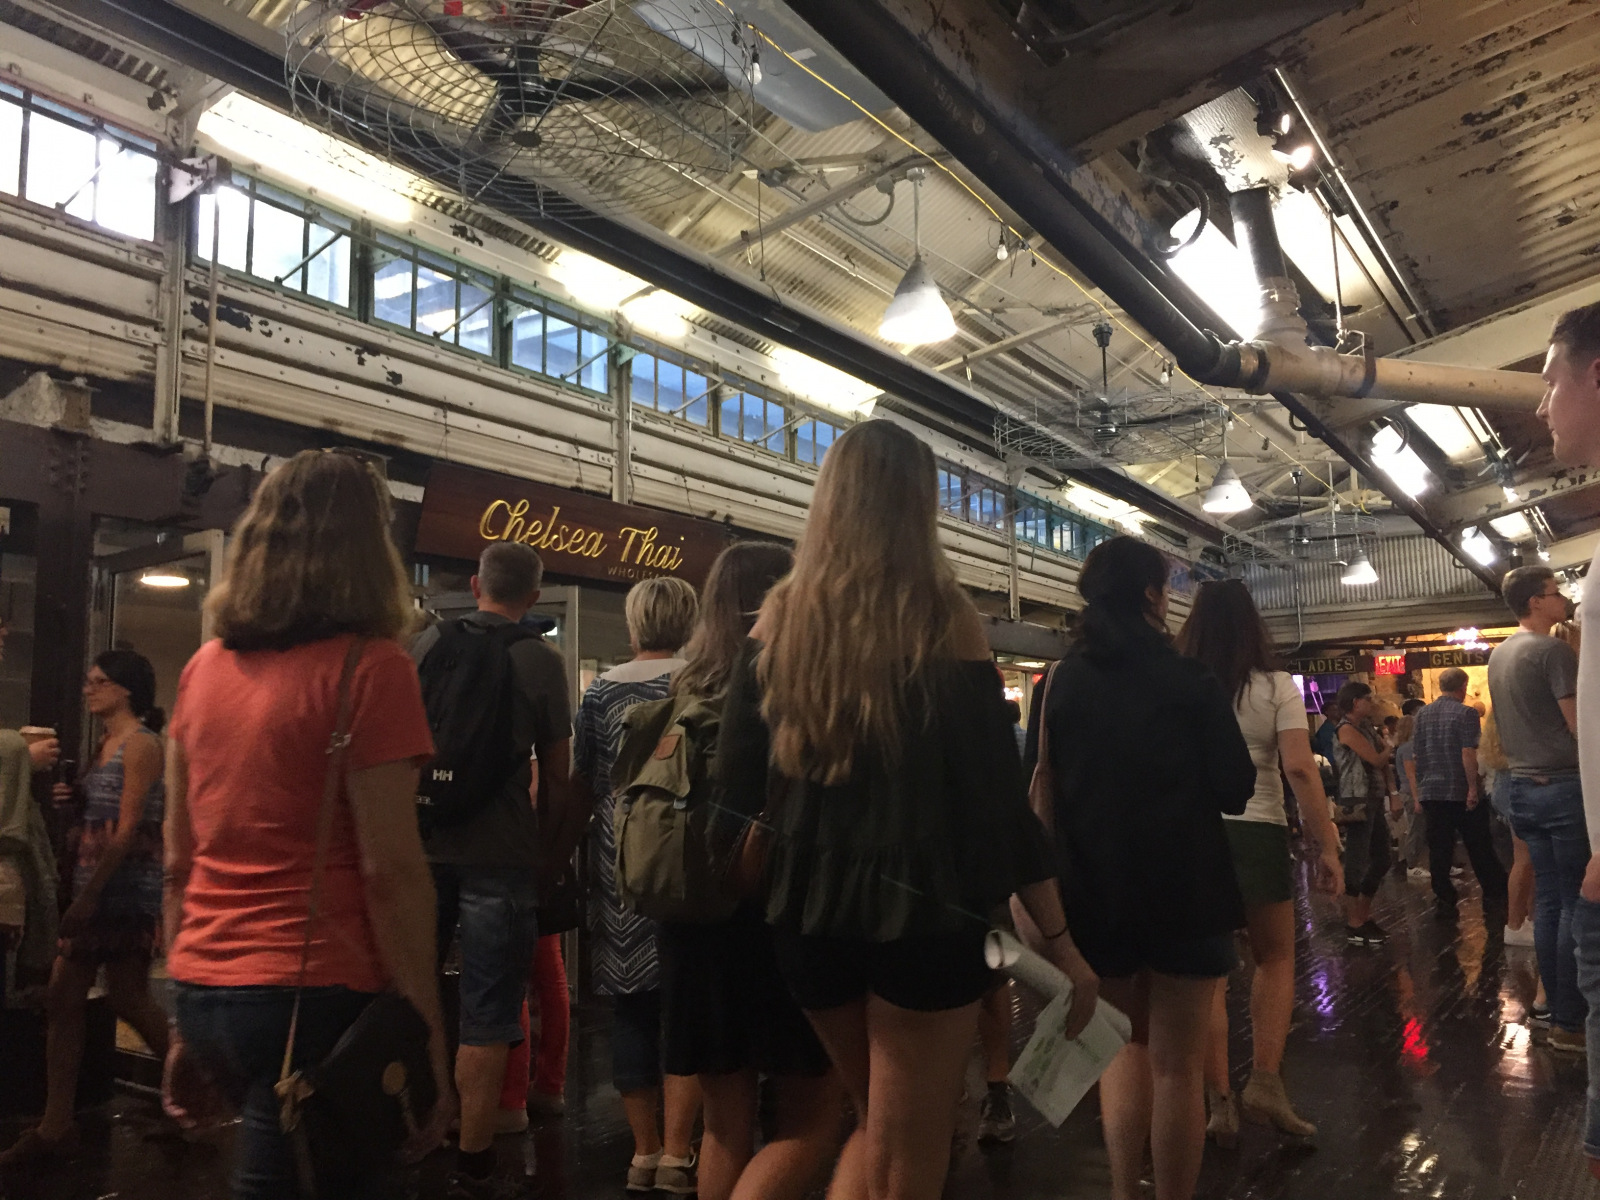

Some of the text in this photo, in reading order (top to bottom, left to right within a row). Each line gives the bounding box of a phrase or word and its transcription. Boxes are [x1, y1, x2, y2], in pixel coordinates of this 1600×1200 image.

[480, 499, 685, 571] Chelsea Thai
[607, 565, 673, 581] WHOLES
[1298, 658, 1354, 674] LADIES
[1378, 655, 1402, 674] EXIT
[1432, 651, 1485, 666] GENTS
[432, 769, 454, 782] HH
